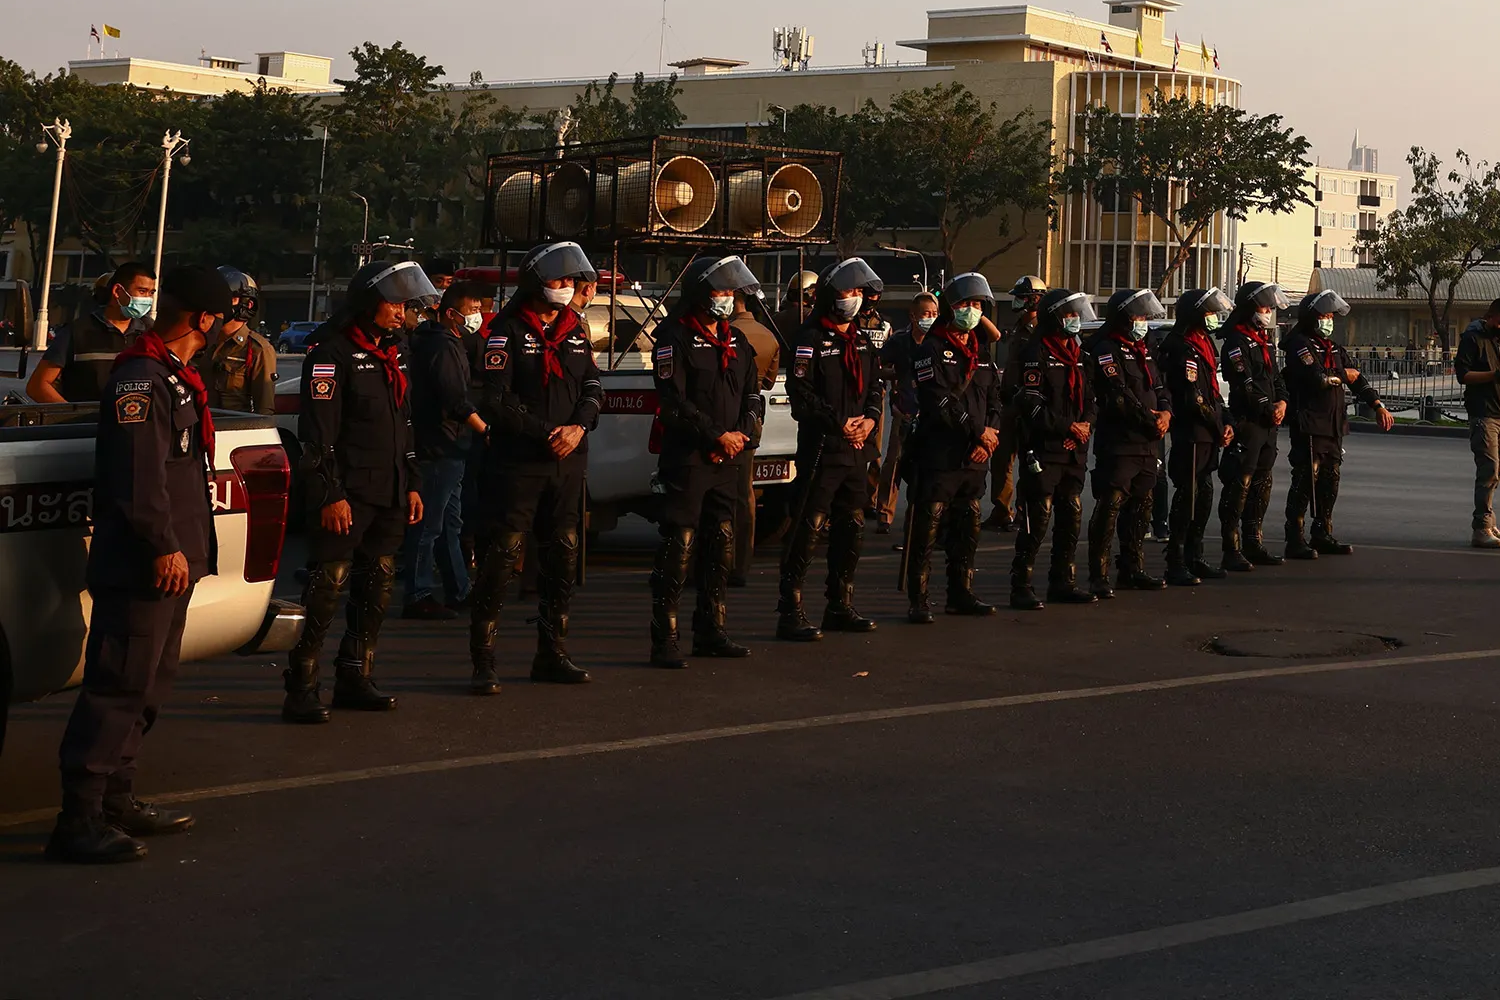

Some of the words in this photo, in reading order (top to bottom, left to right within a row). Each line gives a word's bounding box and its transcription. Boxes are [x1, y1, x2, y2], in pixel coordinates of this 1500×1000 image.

[118, 382, 150, 393] POLICE
[607, 394, 644, 409] บก.น.6
[755, 463, 789, 478] 45764
